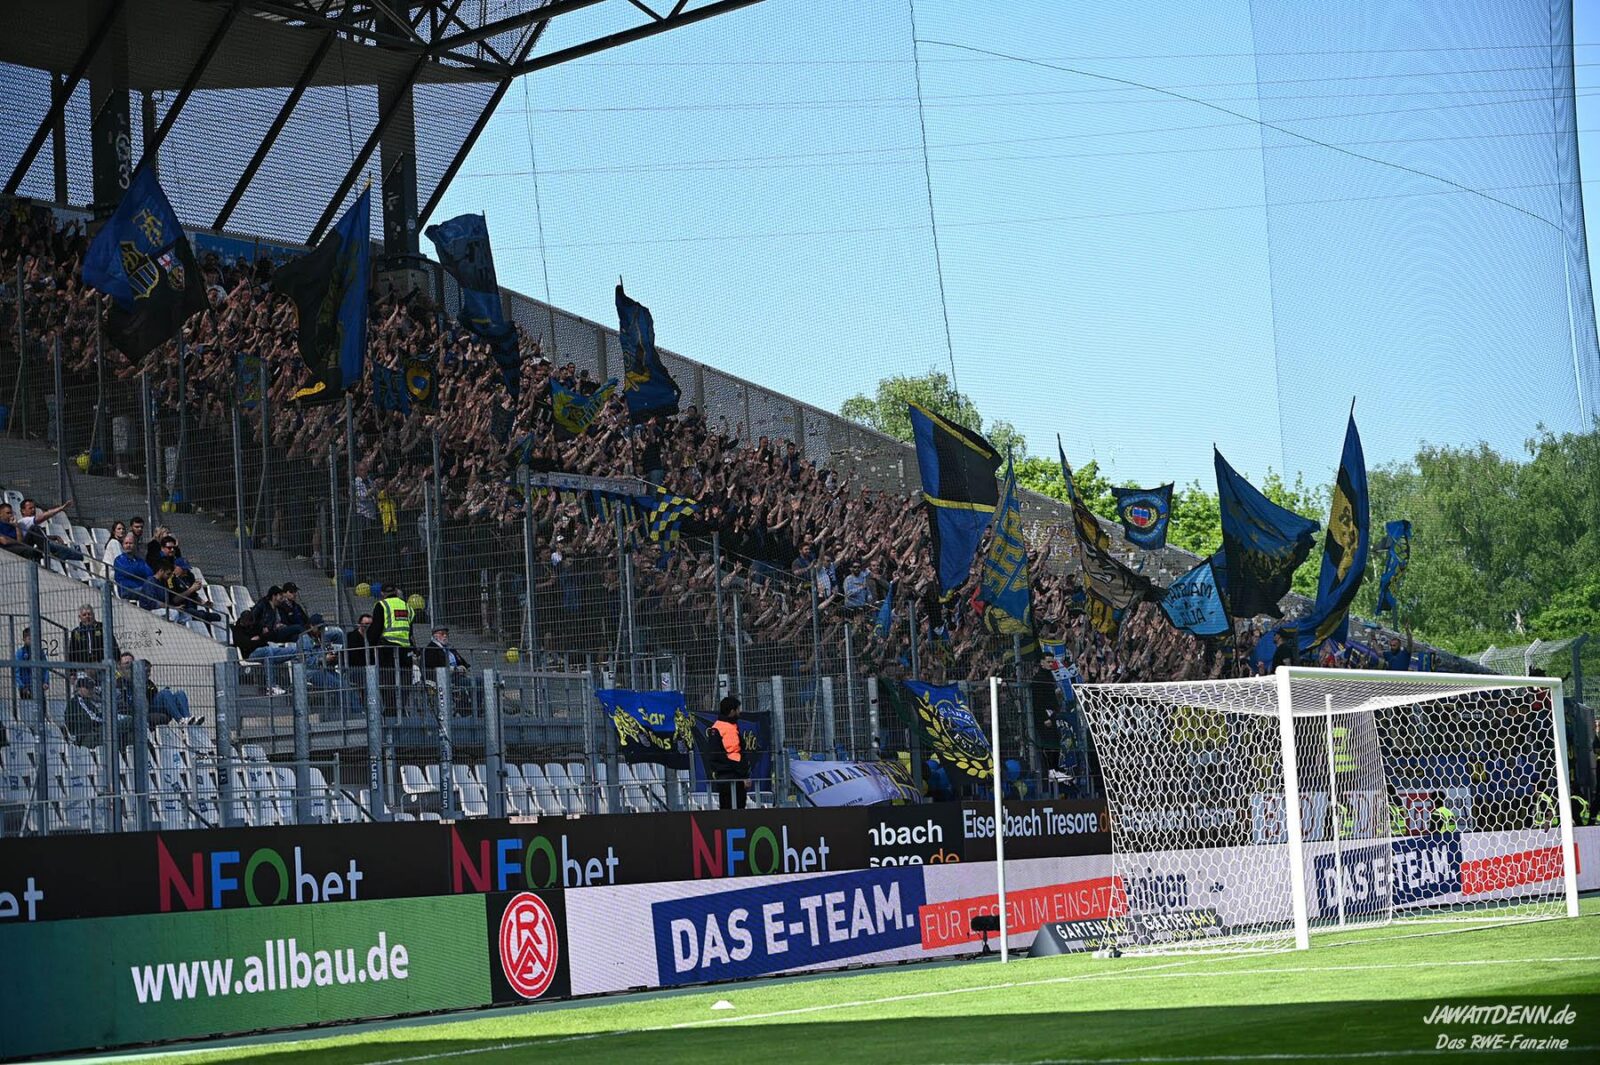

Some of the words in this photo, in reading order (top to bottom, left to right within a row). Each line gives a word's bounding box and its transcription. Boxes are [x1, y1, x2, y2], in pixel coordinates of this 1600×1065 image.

[962, 806, 1042, 839] Eisebach
[670, 907, 753, 974] DAS
[762, 881, 915, 956] E-TEAM.
[924, 904, 963, 943] FÜR
[1030, 897, 1050, 924] IM
[131, 931, 409, 1004] www.allbau.de
